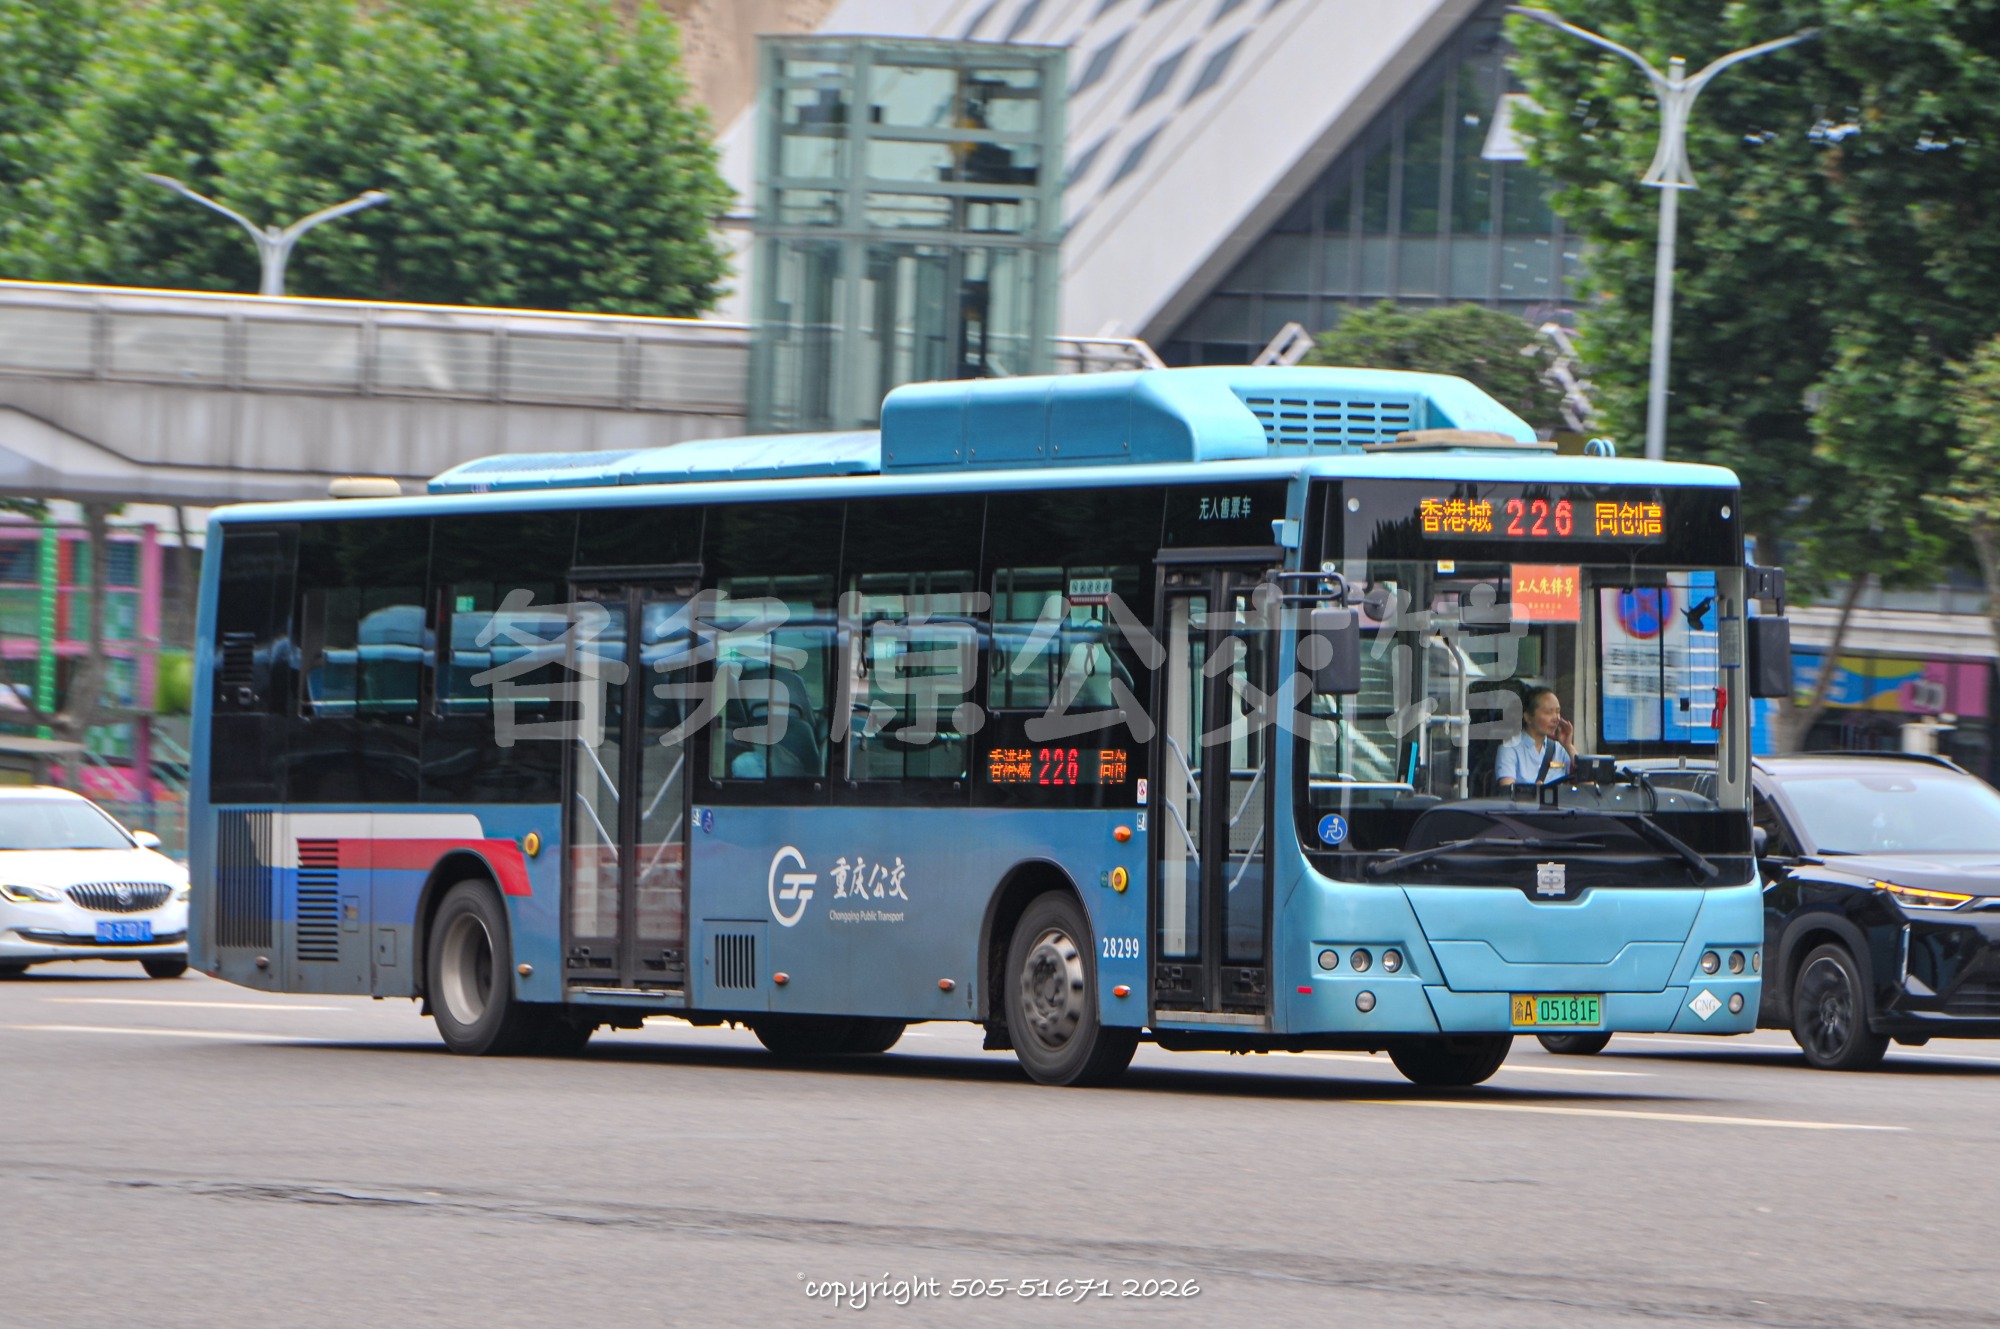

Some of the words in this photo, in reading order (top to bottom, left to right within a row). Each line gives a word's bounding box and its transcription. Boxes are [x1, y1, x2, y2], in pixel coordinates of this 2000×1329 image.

[1199, 495, 1251, 520] 无人售票车
[1420, 498, 1492, 533] 香港城
[1507, 499, 1574, 536] 226
[1516, 576, 1574, 598] 工人先锋号
[1039, 748, 1079, 785] 226
[829, 856, 909, 901] 重庆公交
[829, 909, 860, 924] Chongqing
[860, 909, 877, 921] Public
[877, 910, 904, 924] Transport
[1102, 936, 1140, 959] 28299
[1695, 999, 1716, 1012] CNG
